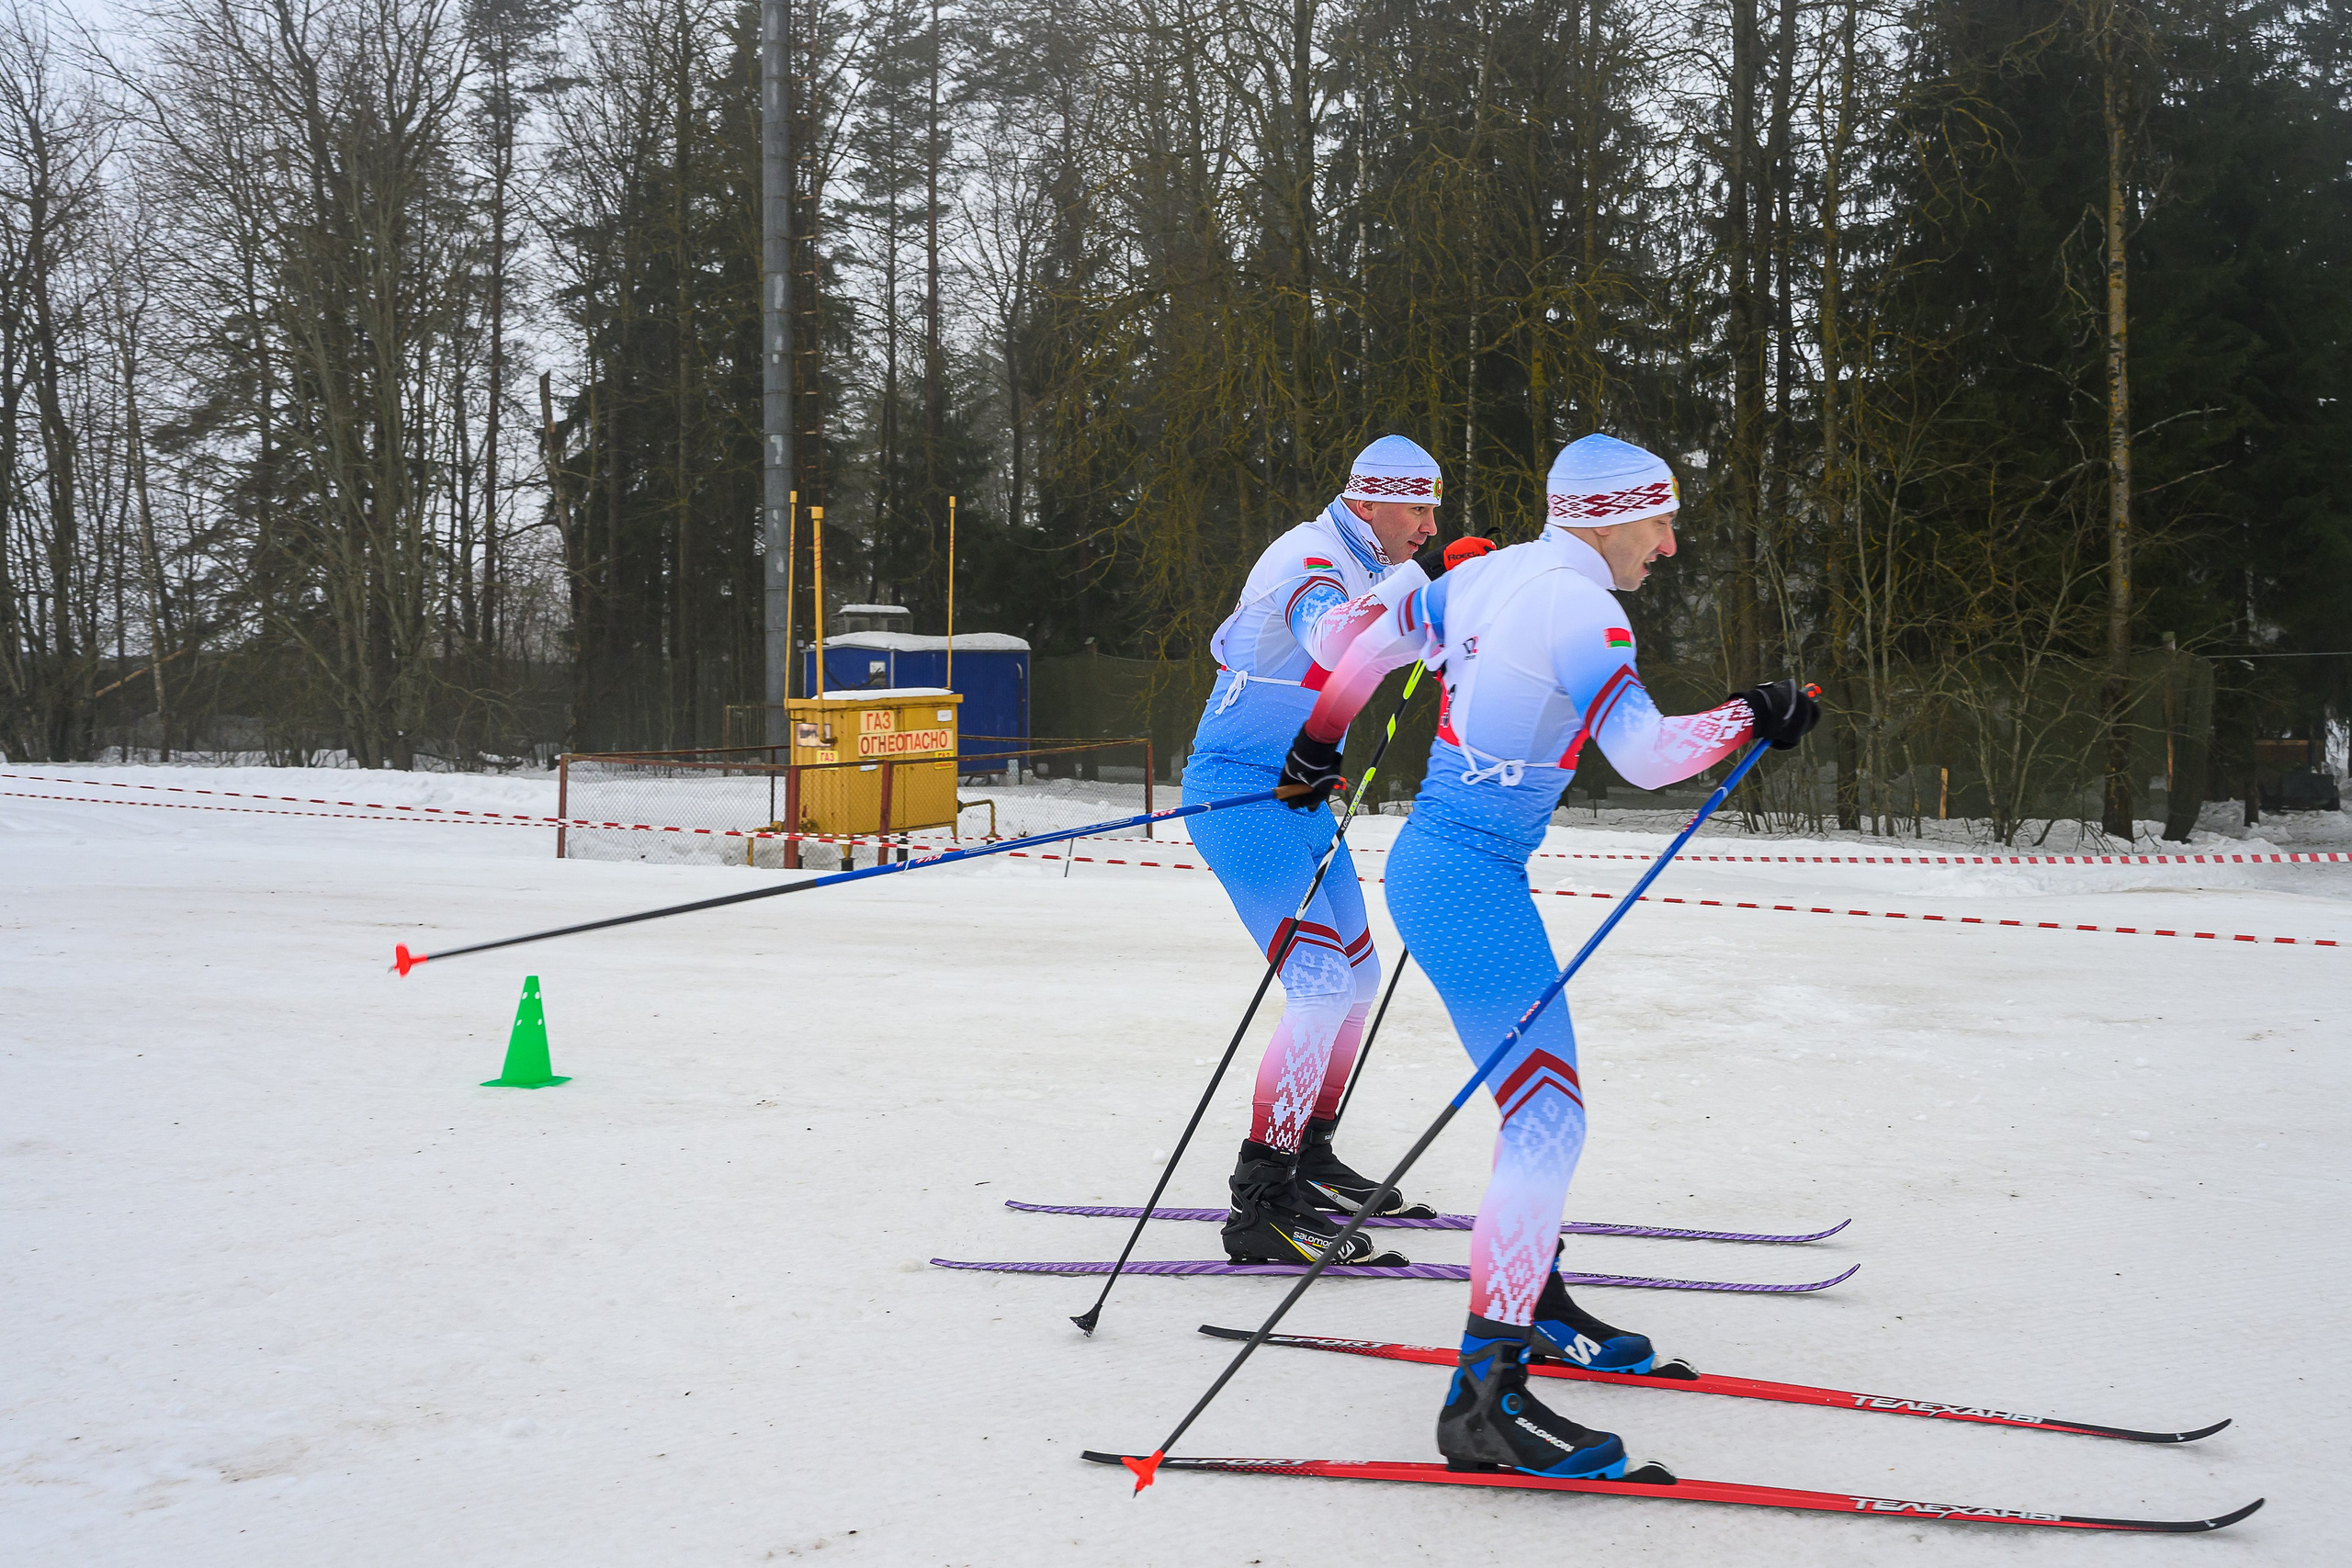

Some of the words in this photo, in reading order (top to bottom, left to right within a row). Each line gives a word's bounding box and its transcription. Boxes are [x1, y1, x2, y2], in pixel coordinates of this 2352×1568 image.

[866, 711, 891, 731] ГАЗ
[860, 730, 948, 755] ОГНЕОПАСНО
[820, 752, 835, 761] ГАЗ
